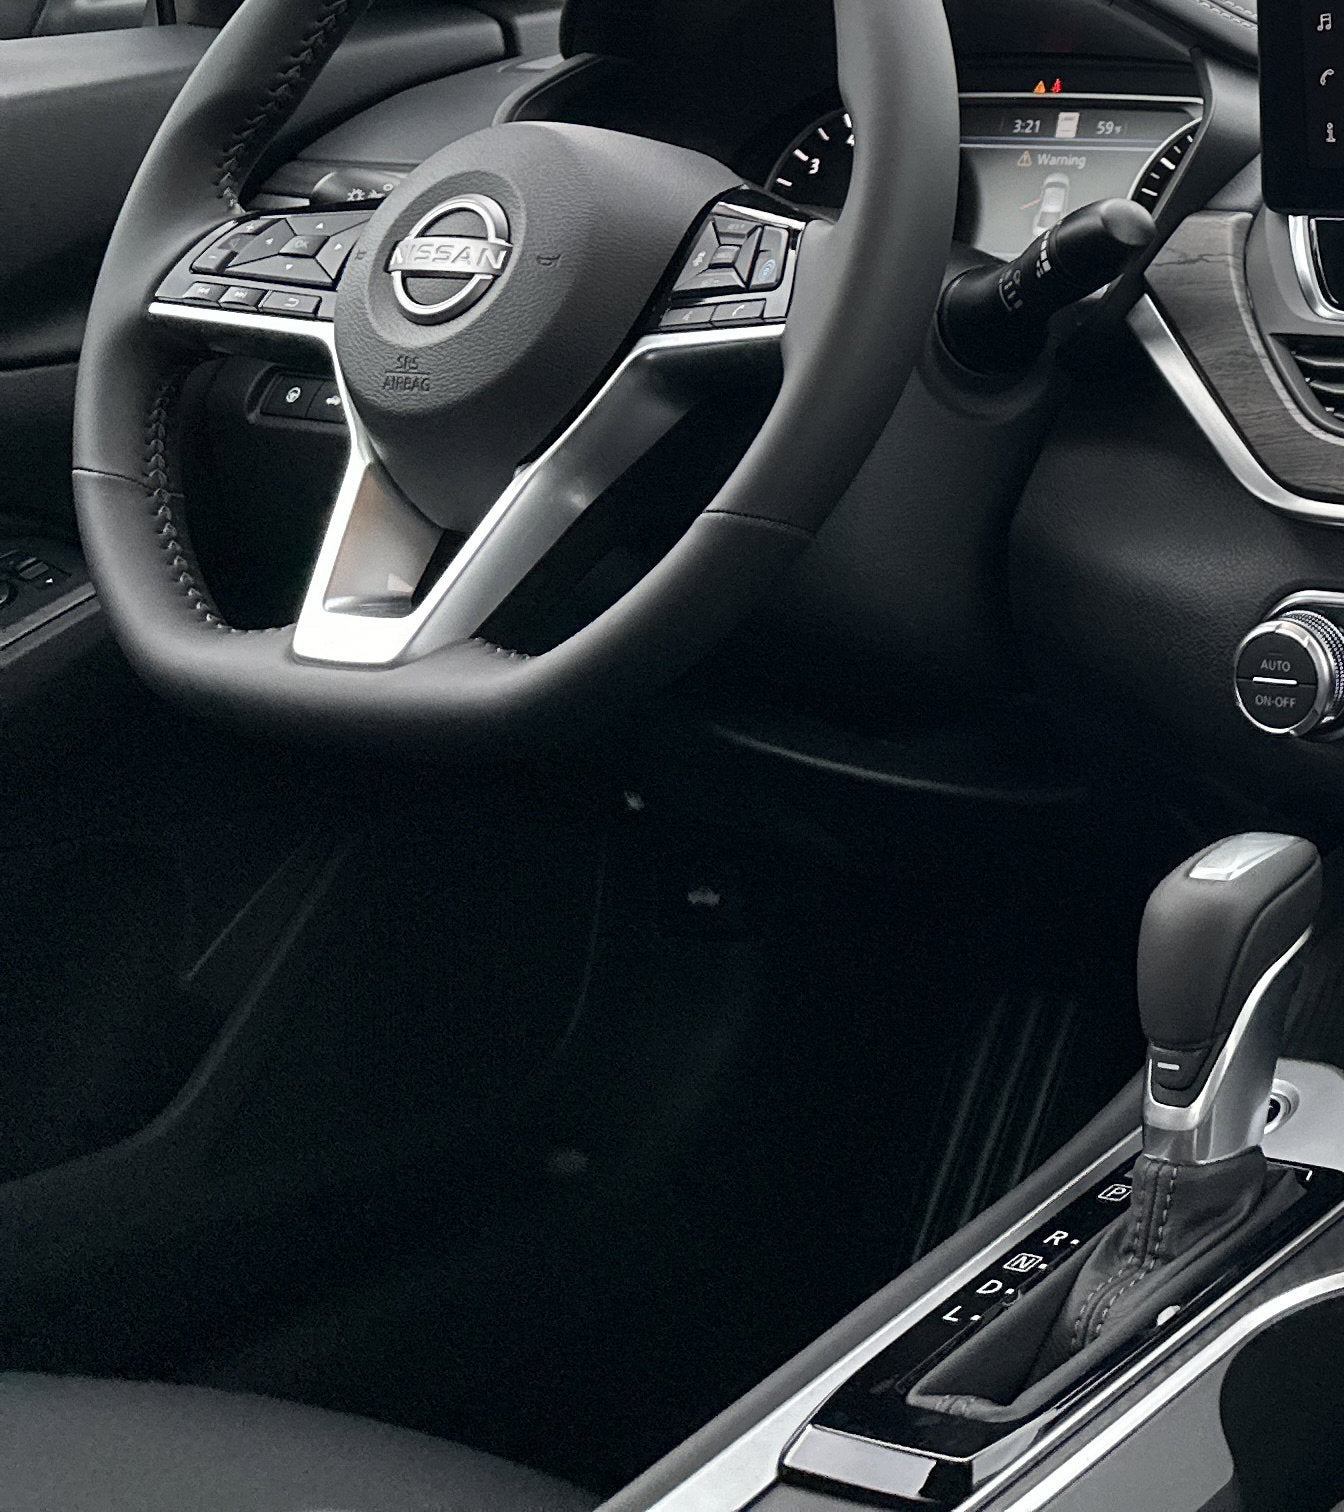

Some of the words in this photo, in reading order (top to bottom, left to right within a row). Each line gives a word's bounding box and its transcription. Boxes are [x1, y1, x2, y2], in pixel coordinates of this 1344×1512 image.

[1013, 119, 1041, 133] 3:21
[808, 157, 820, 175] 3
[1037, 153, 1087, 169] Warning
[390, 243, 507, 271] NISSAN
[396, 355, 420, 370] SRS
[383, 376, 430, 391] AIRBAG
[1260, 659, 1291, 673] AUTO
[1255, 695, 1296, 708] ON-OFF
[1044, 1230, 1067, 1246] R
[976, 1279, 1002, 1294] D
[942, 1305, 962, 1322] L
